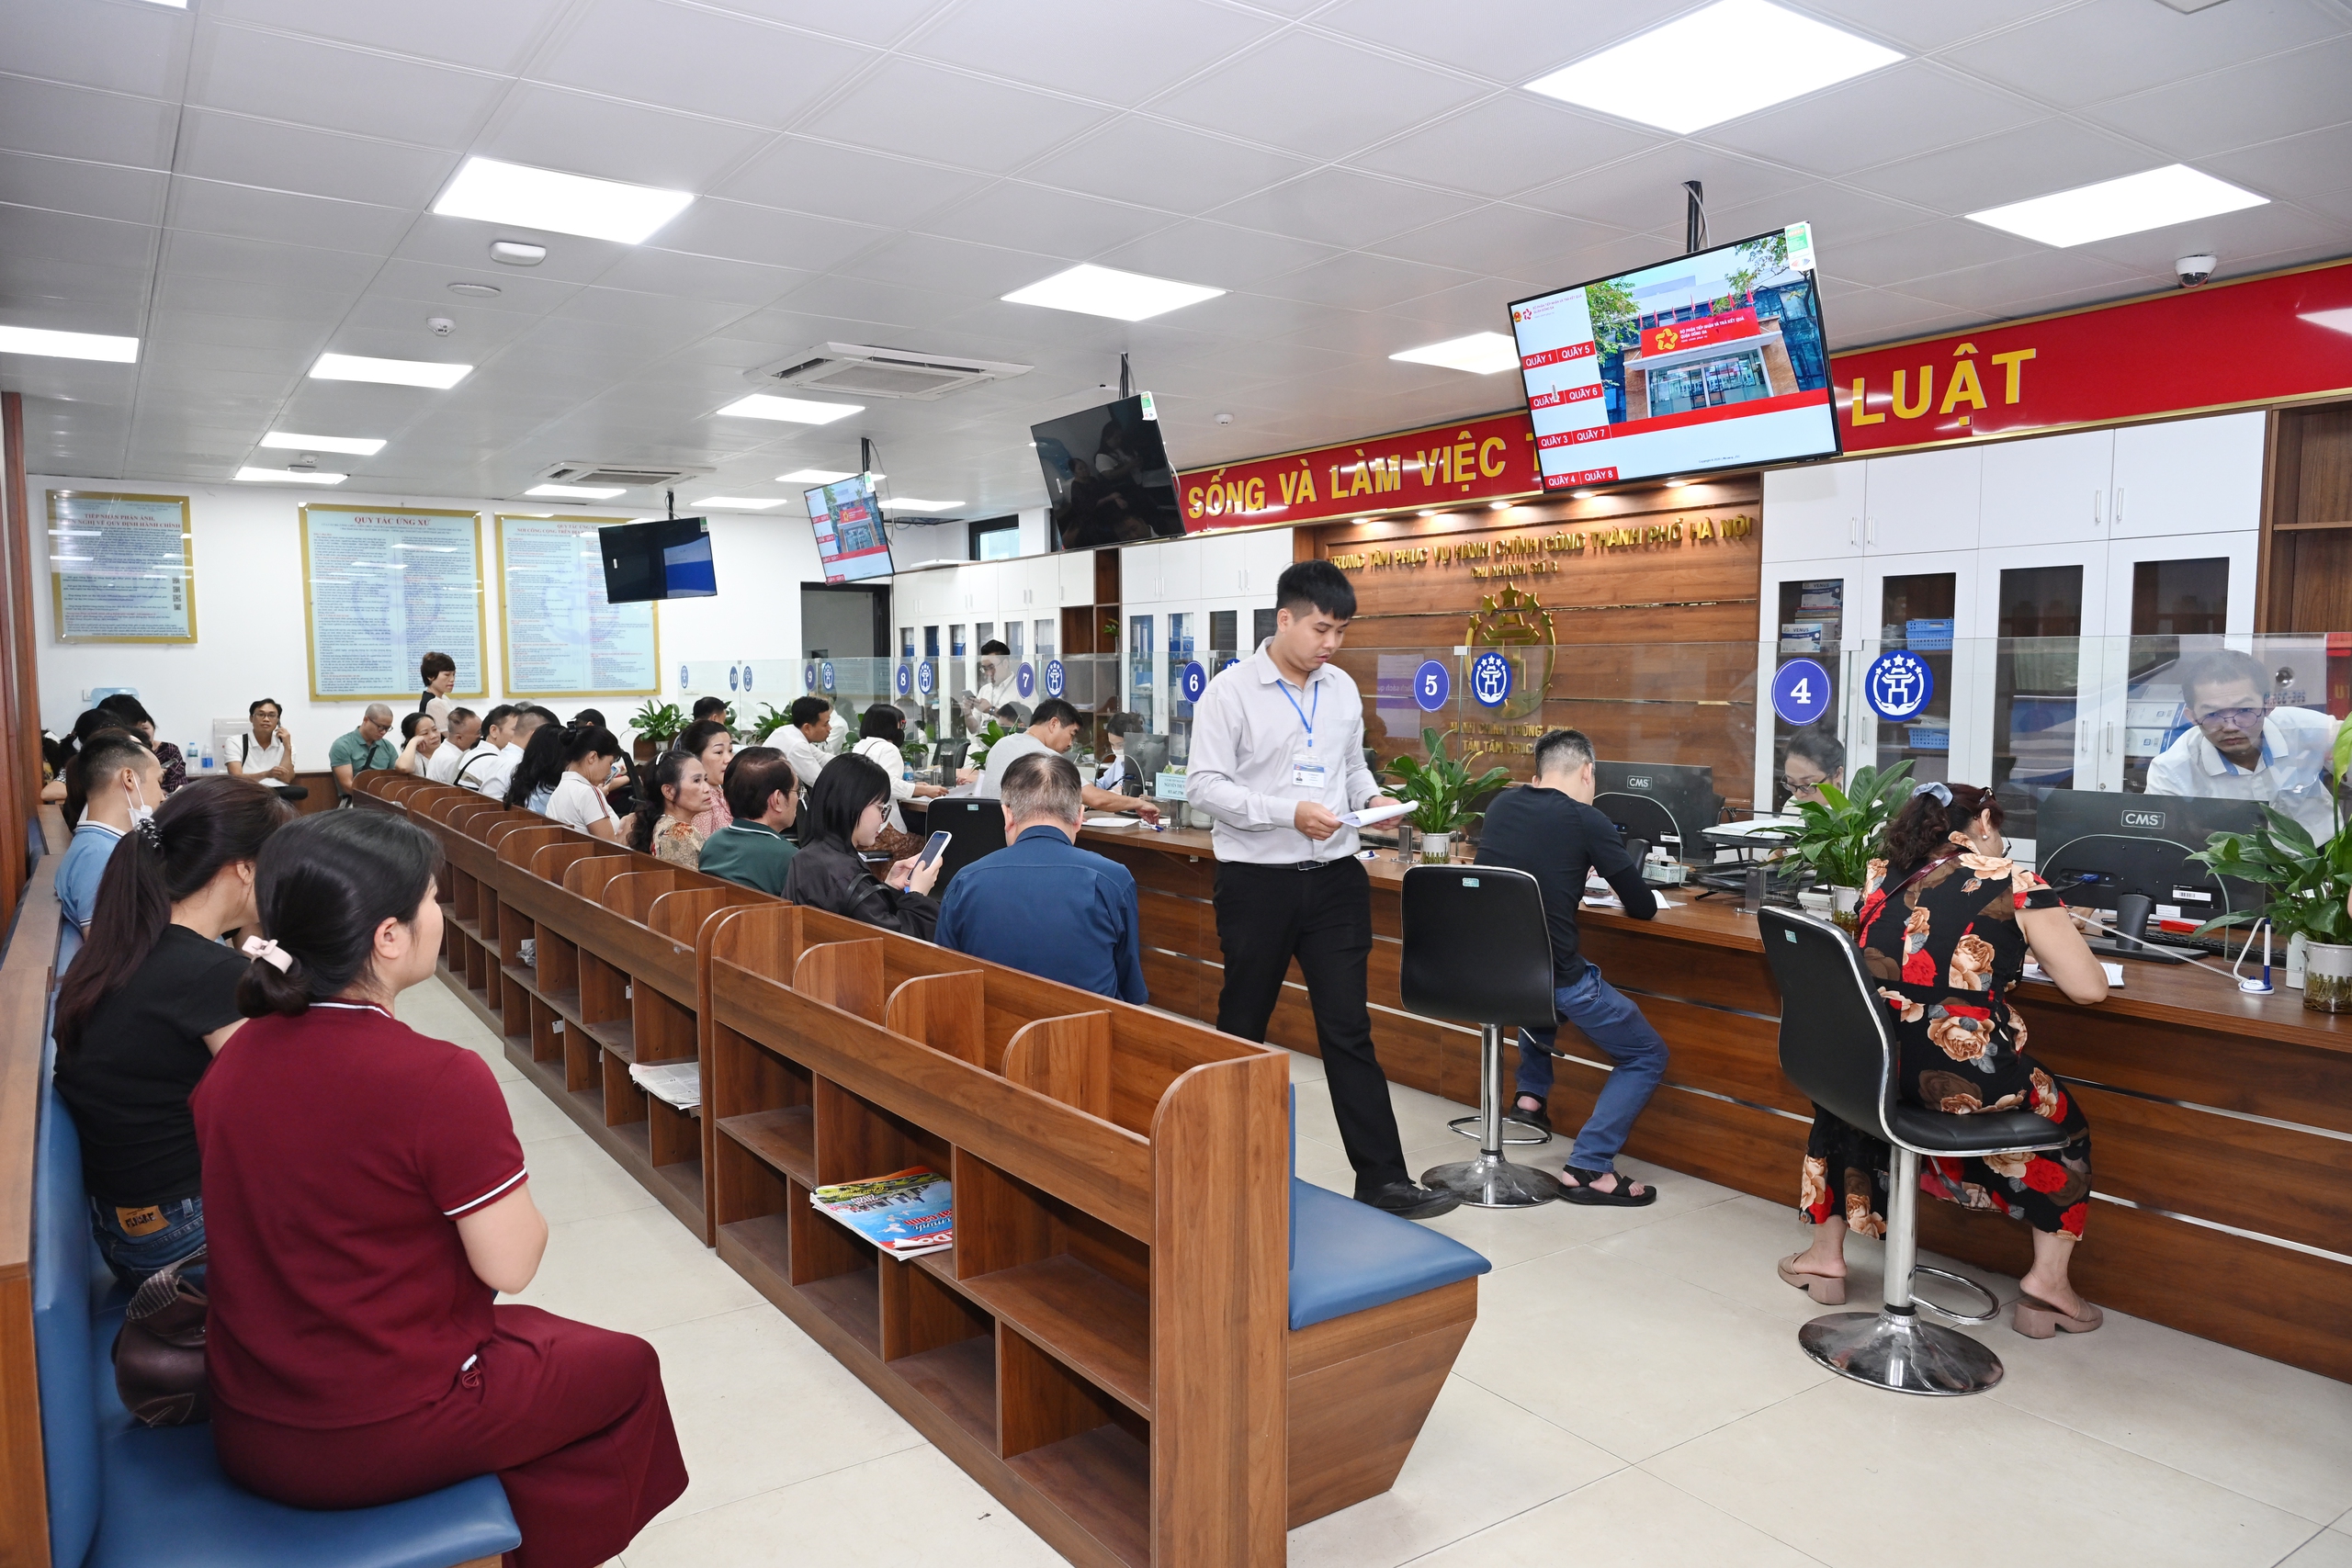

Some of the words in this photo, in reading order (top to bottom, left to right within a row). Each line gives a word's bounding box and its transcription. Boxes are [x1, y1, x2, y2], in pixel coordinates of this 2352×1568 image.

[1562, 346, 1583, 358] QUẦY
[1585, 345, 1590, 354] 5
[1526, 355, 1546, 367] QUẦY
[1569, 389, 1590, 400] QUẦY
[1592, 388, 1598, 396] 6
[1533, 395, 1554, 407] QUẦY
[1188, 468, 1266, 519] SỐNG
[1278, 458, 1317, 506] VÀ
[1330, 449, 1401, 500] LÀM
[1417, 430, 1507, 492] VIỆC
[1851, 342, 2036, 426] LUẬT
[1577, 430, 1599, 441] QUẦY
[1600, 429, 1605, 437] 7
[1541, 435, 1561, 446] QUẦY
[1548, 476, 1569, 486] QUẦY
[1570, 475, 1576, 483] 4
[1584, 470, 1606, 481] QUẦY
[1608, 469, 1613, 479] 8
[355, 516, 374, 525] QUY
[1330, 552, 1364, 570] TRUNG
[1367, 548, 1390, 566] TÂM
[1394, 547, 1428, 568] PHỤC
[1432, 546, 1451, 565] VỤ
[1453, 540, 1491, 559] HÀNH
[1495, 536, 1540, 556] CHÍNH
[1544, 530, 1586, 551] CÔNG
[1589, 525, 1643, 548] THÀNH
[1647, 517, 1684, 543] PHỐ
[1689, 516, 1714, 540] HÀ
[1719, 513, 1753, 540] NỘI
[1471, 565, 1488, 578] CHI
[1491, 561, 1526, 577] NHÁNH
[1530, 558, 1545, 574] SỐ
[1550, 560, 1558, 573] 3
[730, 673, 738, 683] 10
[808, 671, 813, 682] 9
[900, 672, 906, 685] 8
[1022, 672, 1030, 687] 7
[1189, 673, 1199, 692] 6
[1424, 674, 1438, 695] 5
[1791, 678, 1812, 704] 4
[1511, 722, 1544, 738] THÔNG
[1483, 739, 1504, 753] TÂM
[1629, 778, 1648, 787] CMS
[2125, 813, 2159, 826] CMS
